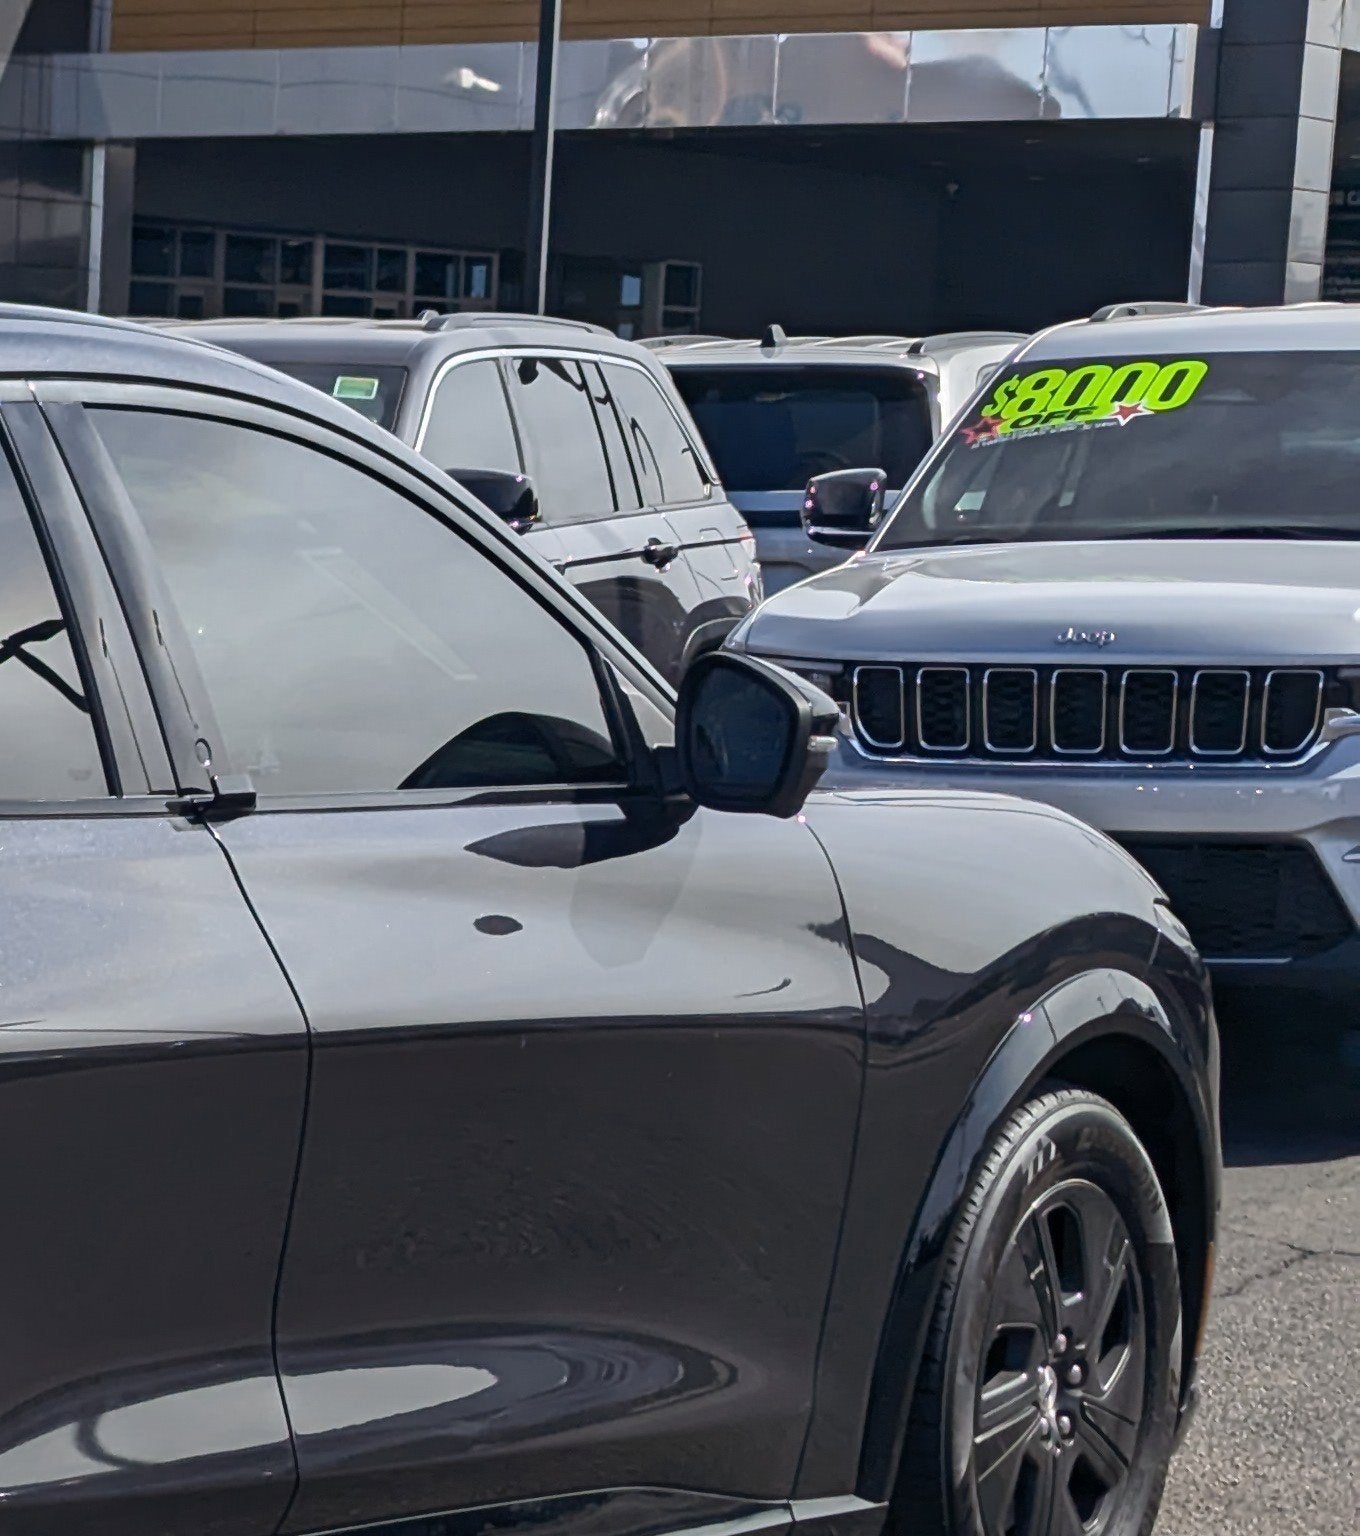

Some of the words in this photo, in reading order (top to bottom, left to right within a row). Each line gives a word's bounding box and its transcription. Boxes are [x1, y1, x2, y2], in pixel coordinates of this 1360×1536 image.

[982, 360, 1209, 421] $8000
[1009, 405, 1098, 430] OFF
[1056, 627, 1116, 646] Jeep
